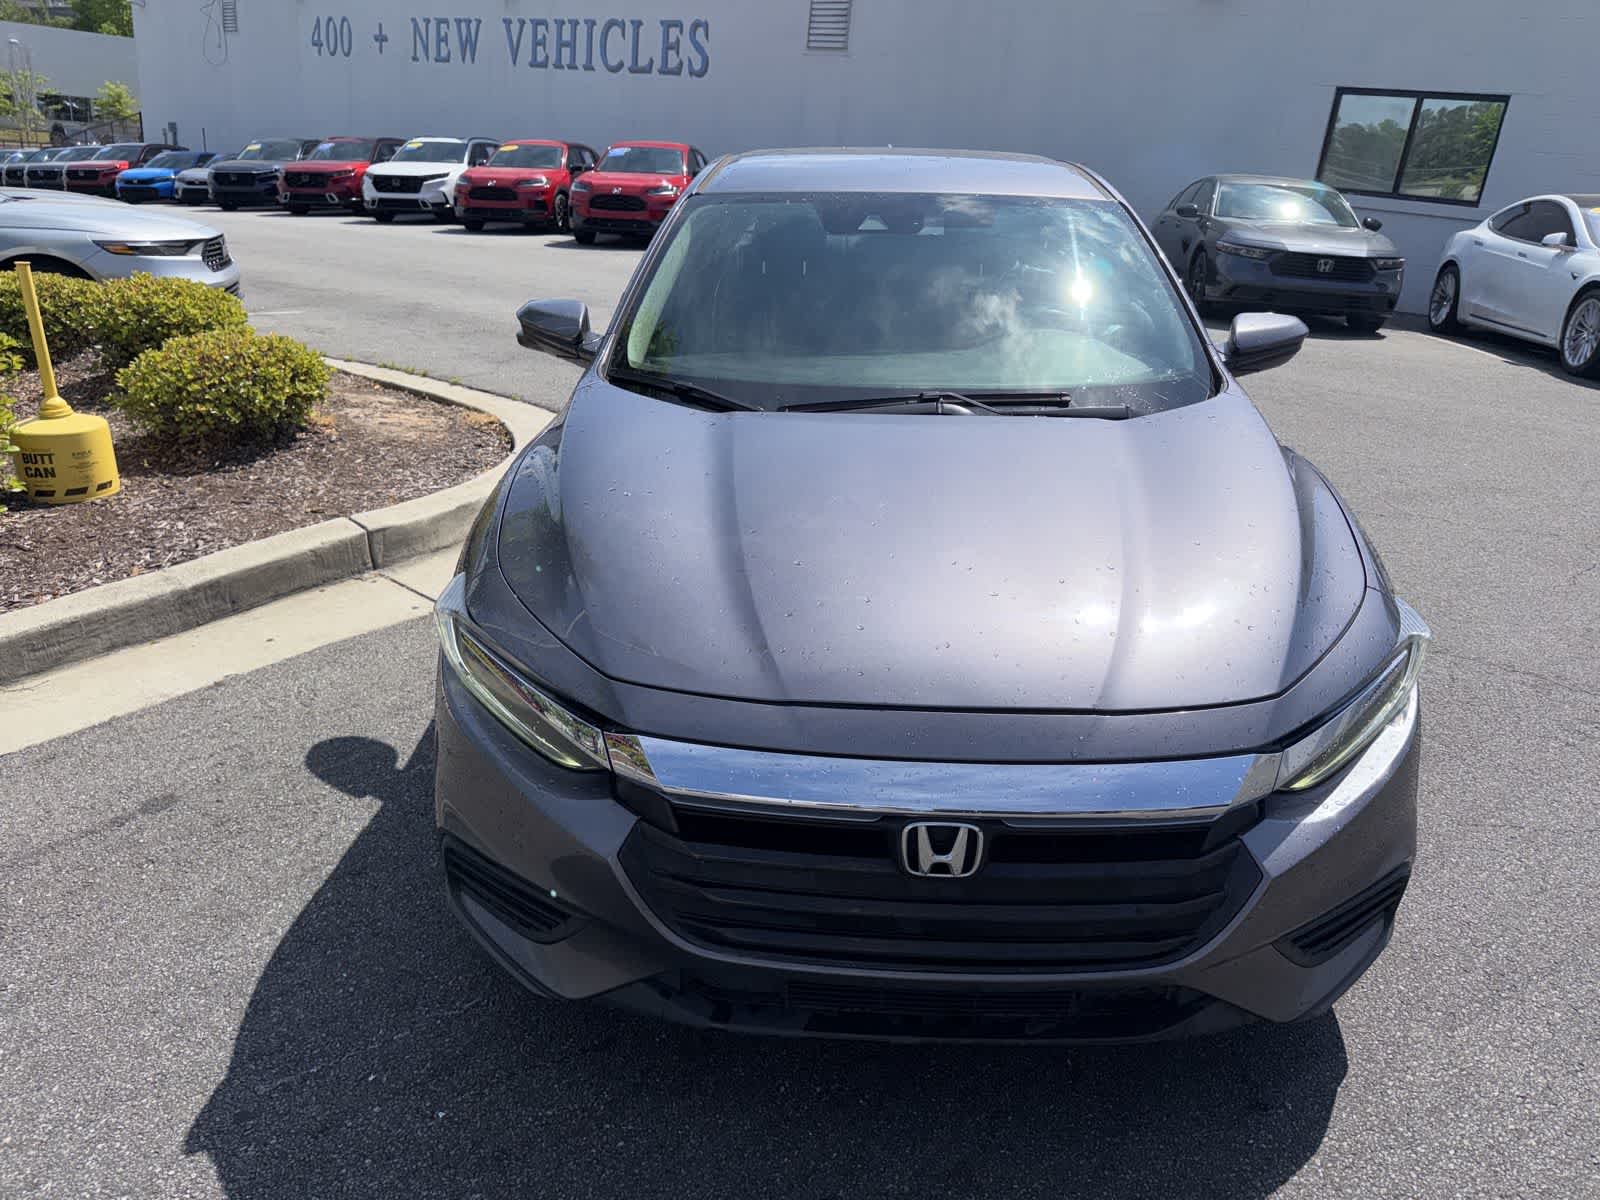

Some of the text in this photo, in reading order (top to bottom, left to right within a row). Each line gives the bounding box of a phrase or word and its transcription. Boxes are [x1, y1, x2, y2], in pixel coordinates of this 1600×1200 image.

[311, 15, 353, 58] 400
[411, 16, 482, 65] NEW
[502, 17, 710, 79] VEHICLES
[21, 453, 55, 465] BUTT
[25, 466, 56, 478] CAN
